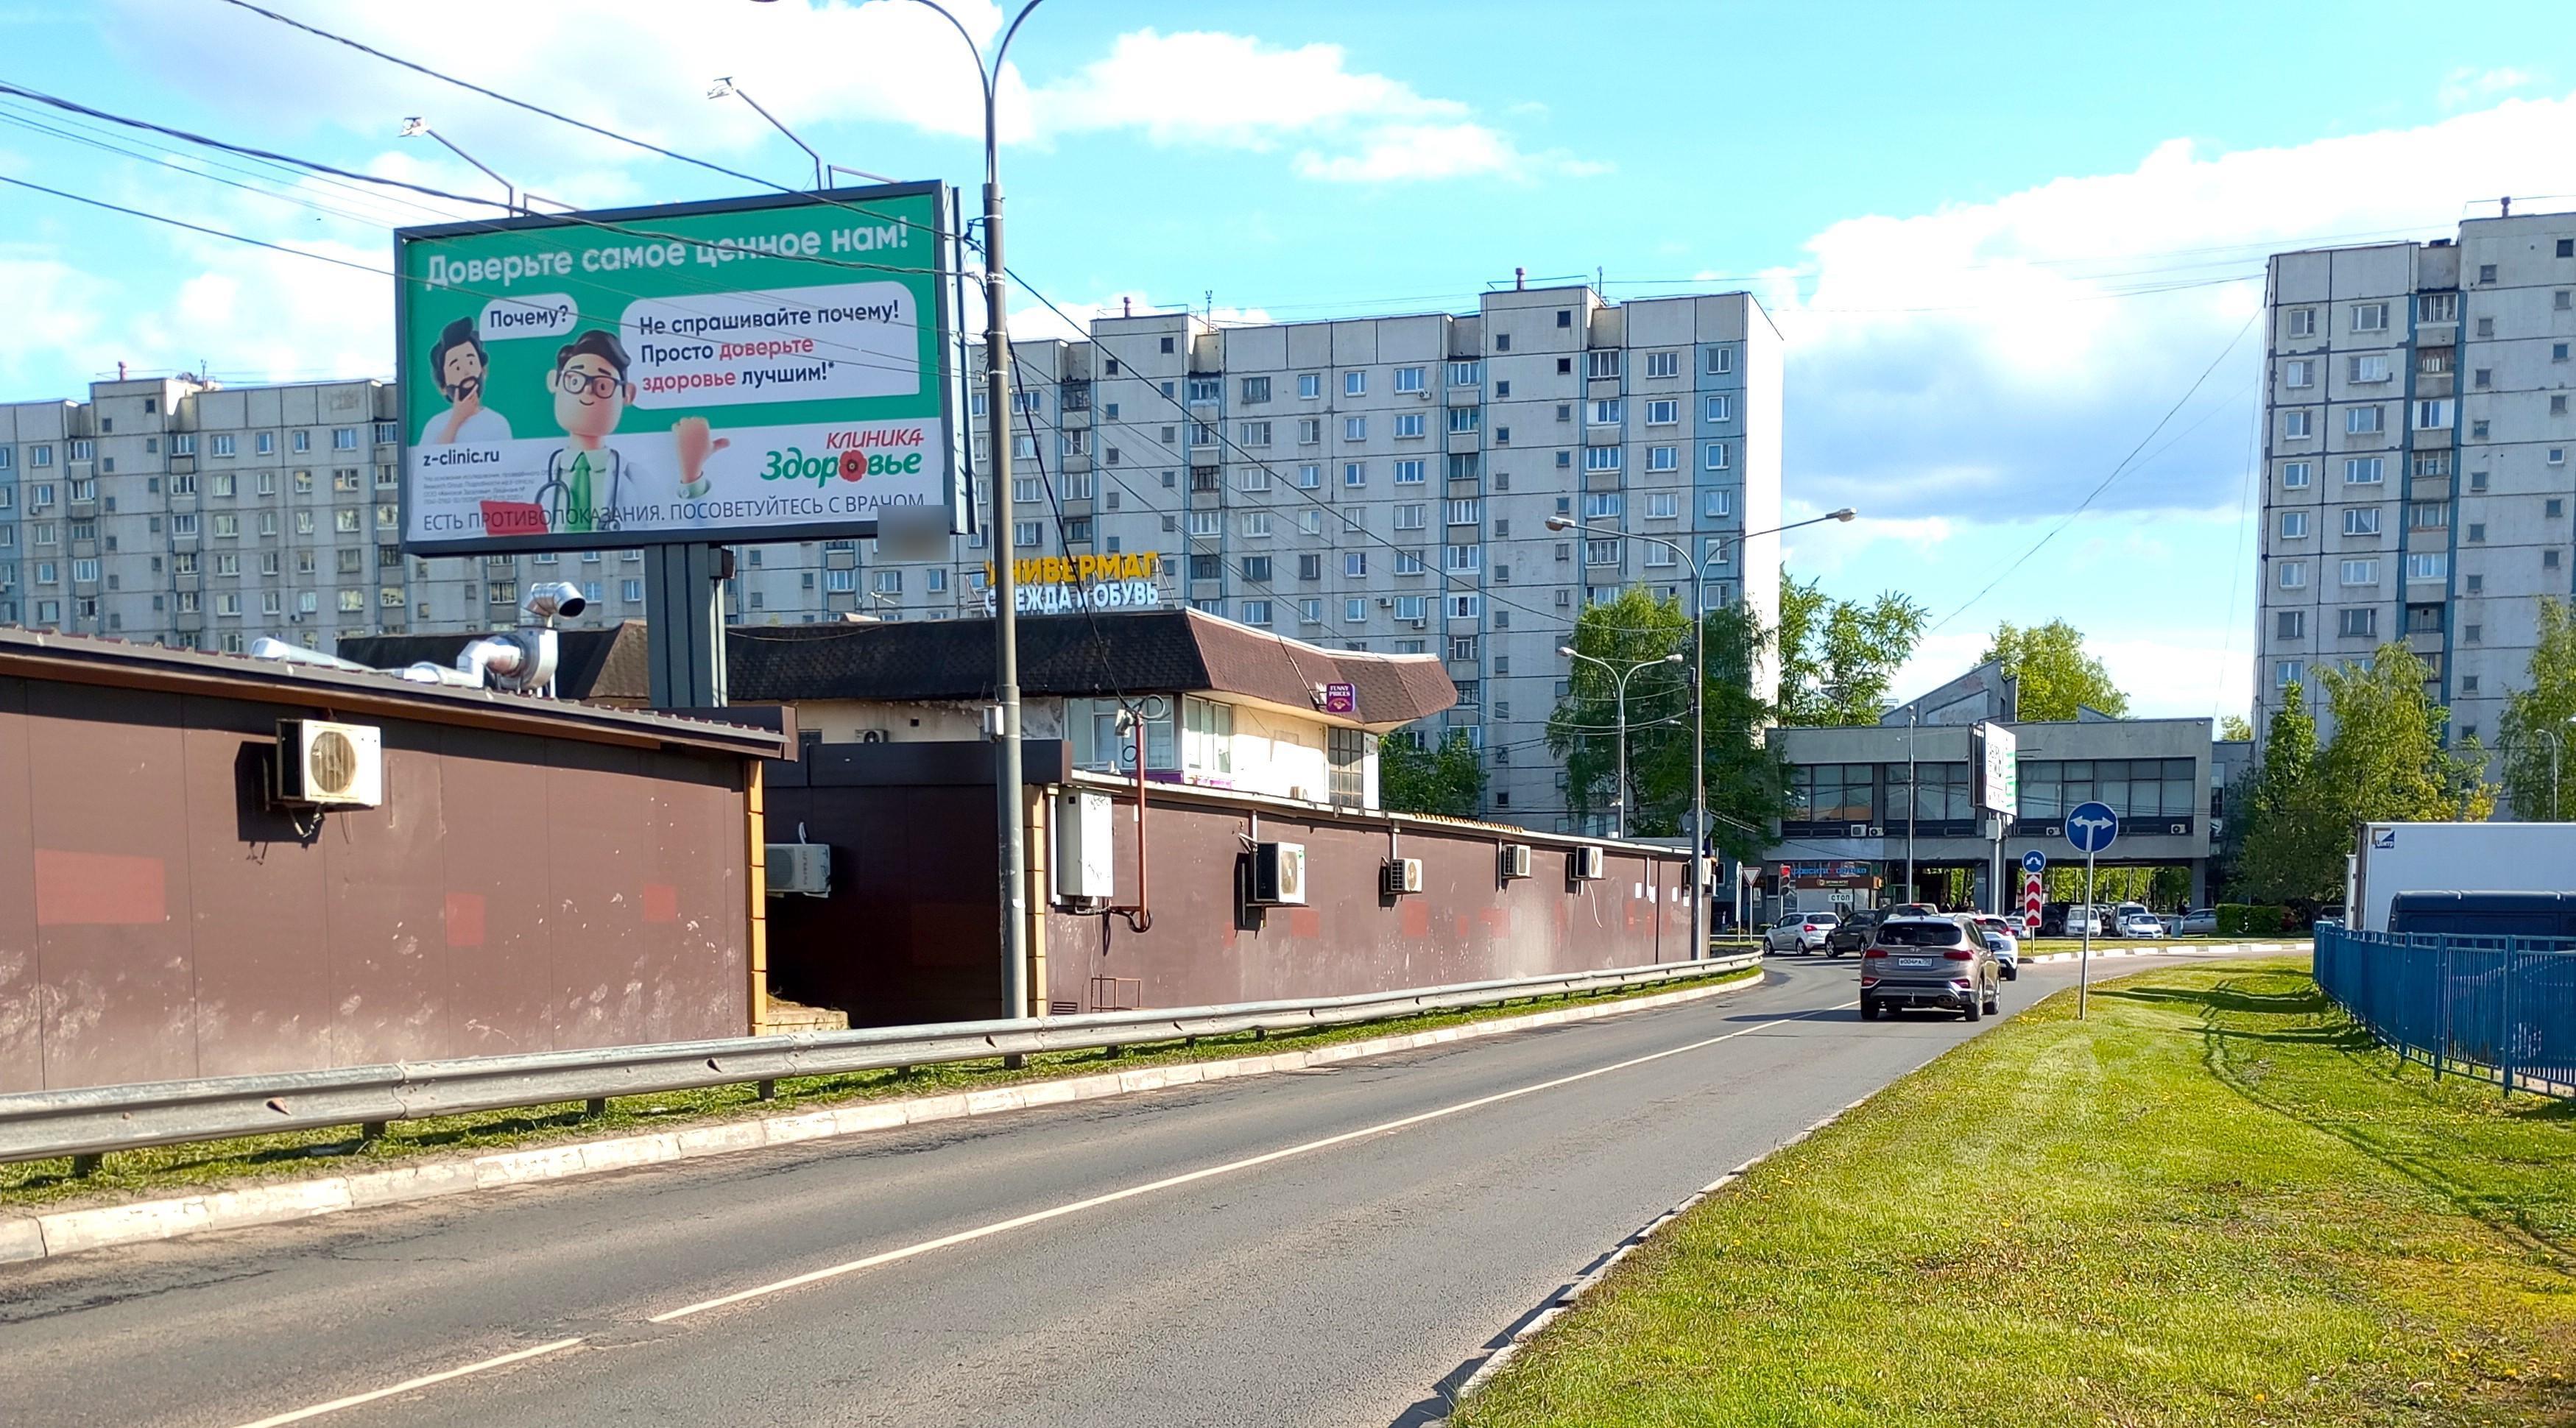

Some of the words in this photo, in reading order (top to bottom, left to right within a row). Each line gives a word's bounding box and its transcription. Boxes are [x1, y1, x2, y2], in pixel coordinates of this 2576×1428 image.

[426, 251, 574, 291] Доверьте
[582, 242, 686, 272] самое
[696, 233, 822, 267] ценное
[831, 216, 908, 252] нам!
[490, 304, 568, 328] Почему?
[639, 316, 666, 336] Не
[671, 308, 812, 336] спрашивайте
[817, 300, 900, 324] почему!
[641, 344, 713, 367] Просто
[719, 337, 814, 361] доверьте
[642, 370, 736, 394] здоровье
[423, 448, 500, 467] z-clinic.ru
[423, 514, 464, 531] ЕСТЬ
[468, 503, 666, 529] ПРОТИВОПОКАЗАНИЯ.
[670, 495, 823, 521] ПОСОВЕТУЙТЕСЬ
[828, 496, 840, 513] С
[1093, 581, 1160, 608] ОБУВЬ
